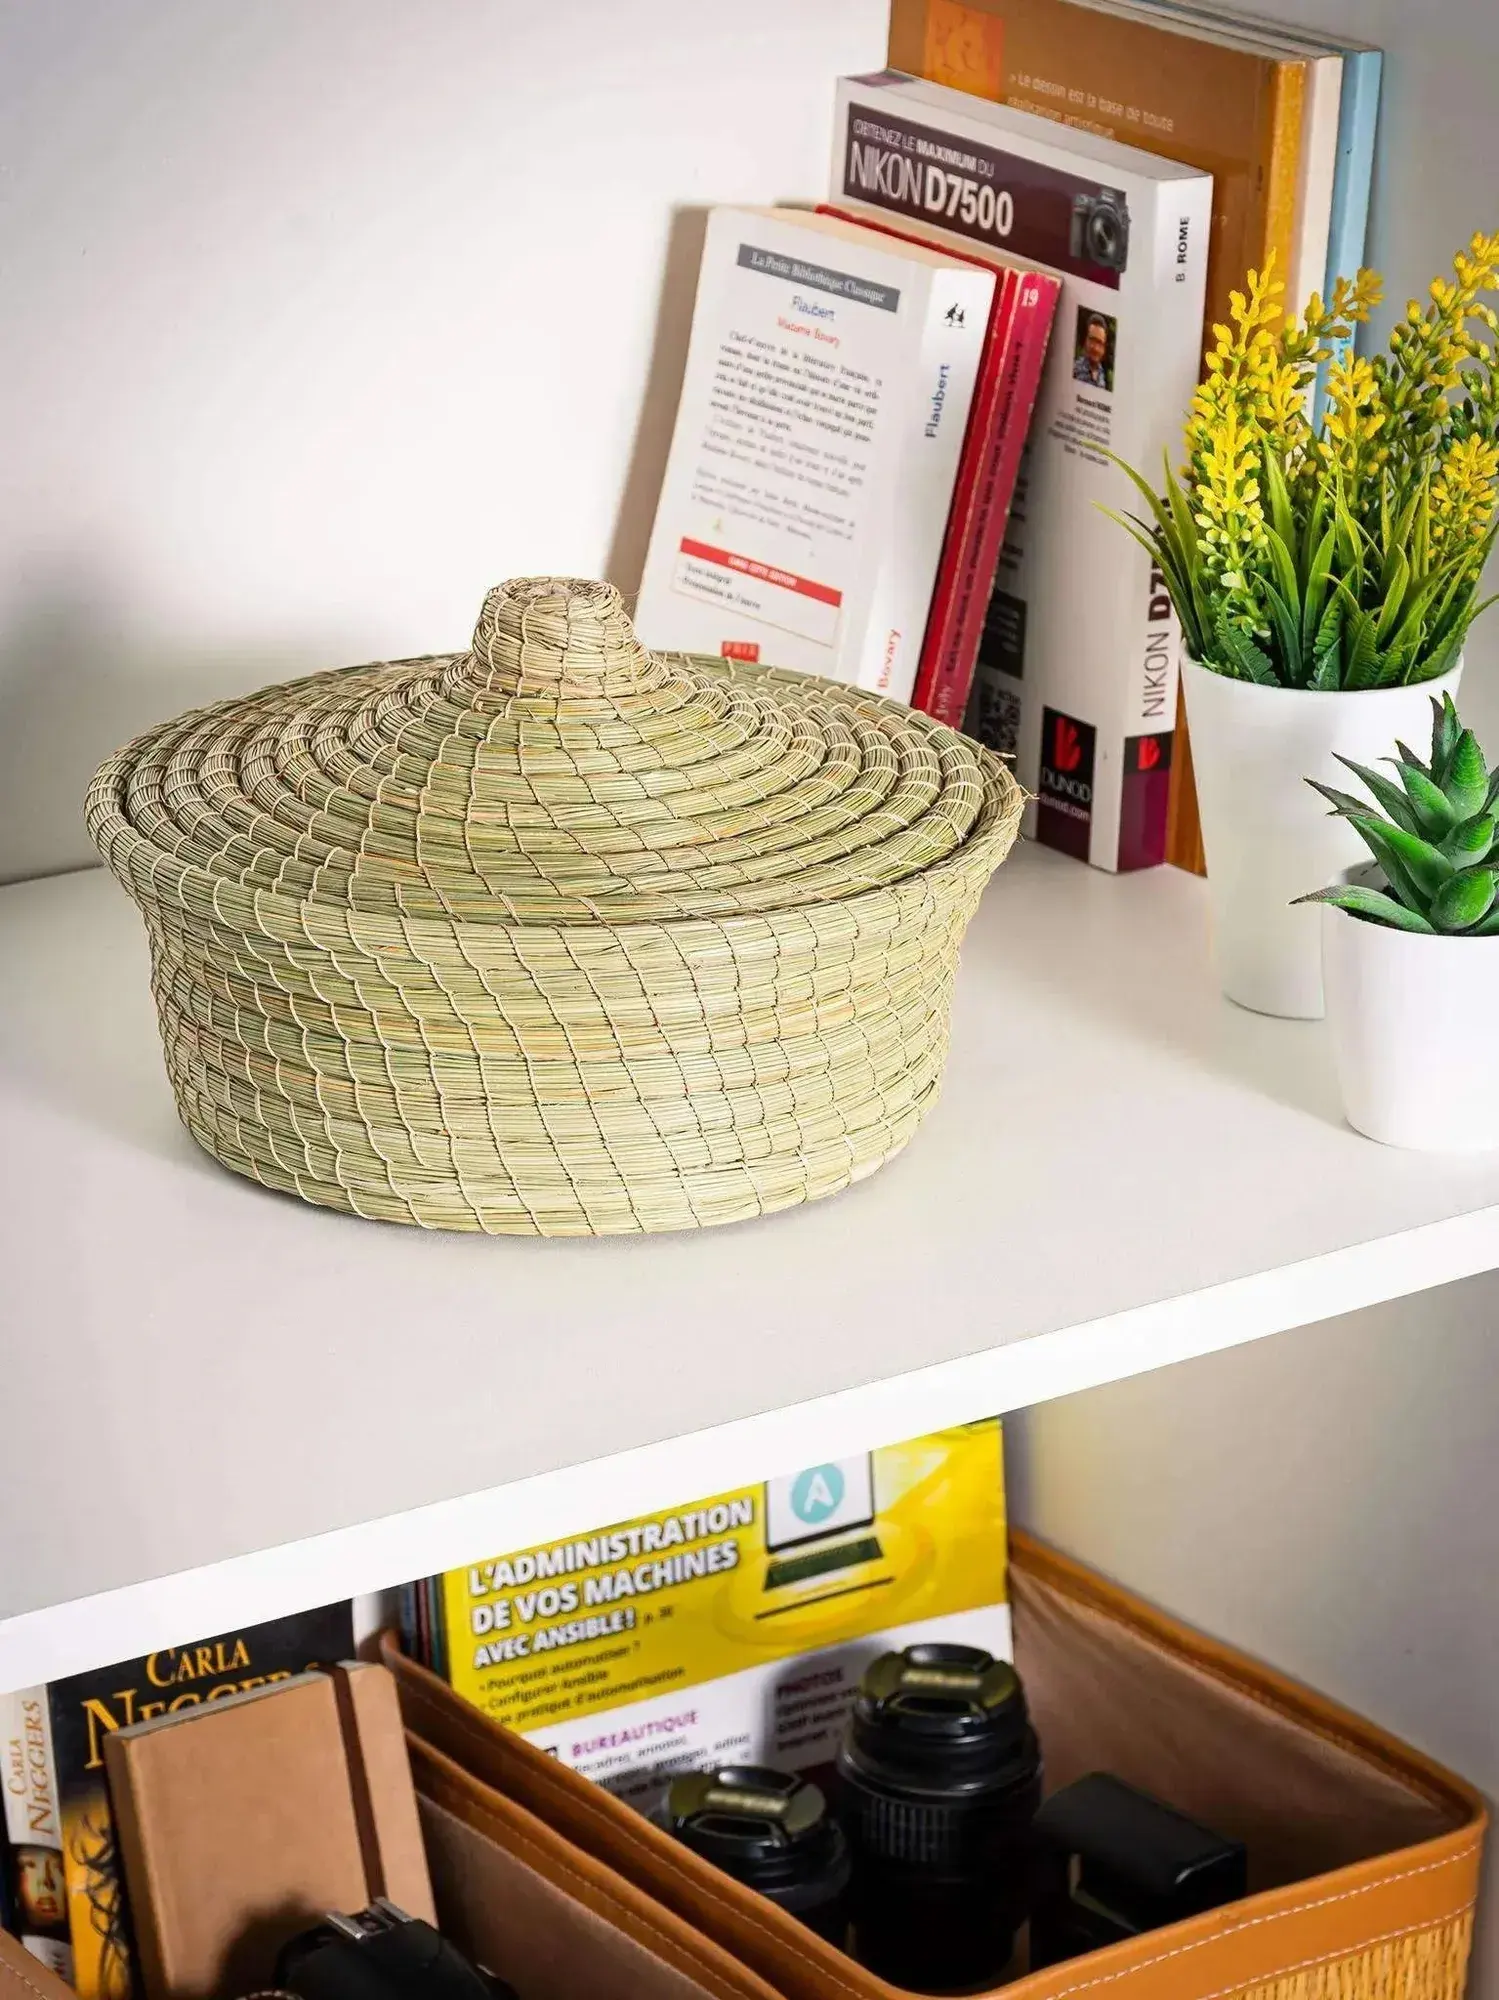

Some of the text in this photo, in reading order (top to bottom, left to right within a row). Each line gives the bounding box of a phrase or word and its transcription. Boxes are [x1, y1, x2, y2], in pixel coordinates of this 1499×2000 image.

[1032, 77, 1066, 98] dessin
[1068, 88, 1085, 104] est
[1098, 94, 1124, 117] base
[853, 119, 994, 178] OBTENEZ LE MAXIMUM DU
[849, 140, 1013, 236] NIKON D7500
[1177, 216, 1190, 263] ROME
[1021, 288, 1039, 307] 19
[925, 364, 950, 438] Flaubert
[877, 628, 901, 688] Bovary
[1141, 632, 1169, 718] NIKON
[1042, 766, 1091, 802] DUNOD
[469, 1497, 753, 1597] L'ADMINISTRATION
[472, 1539, 738, 1635] DE VOS MACHINES
[474, 1634, 530, 1669] AVEC
[570, 1709, 699, 1757] BUREAUTIQUE
[22, 1700, 54, 1836] NEGGERS
